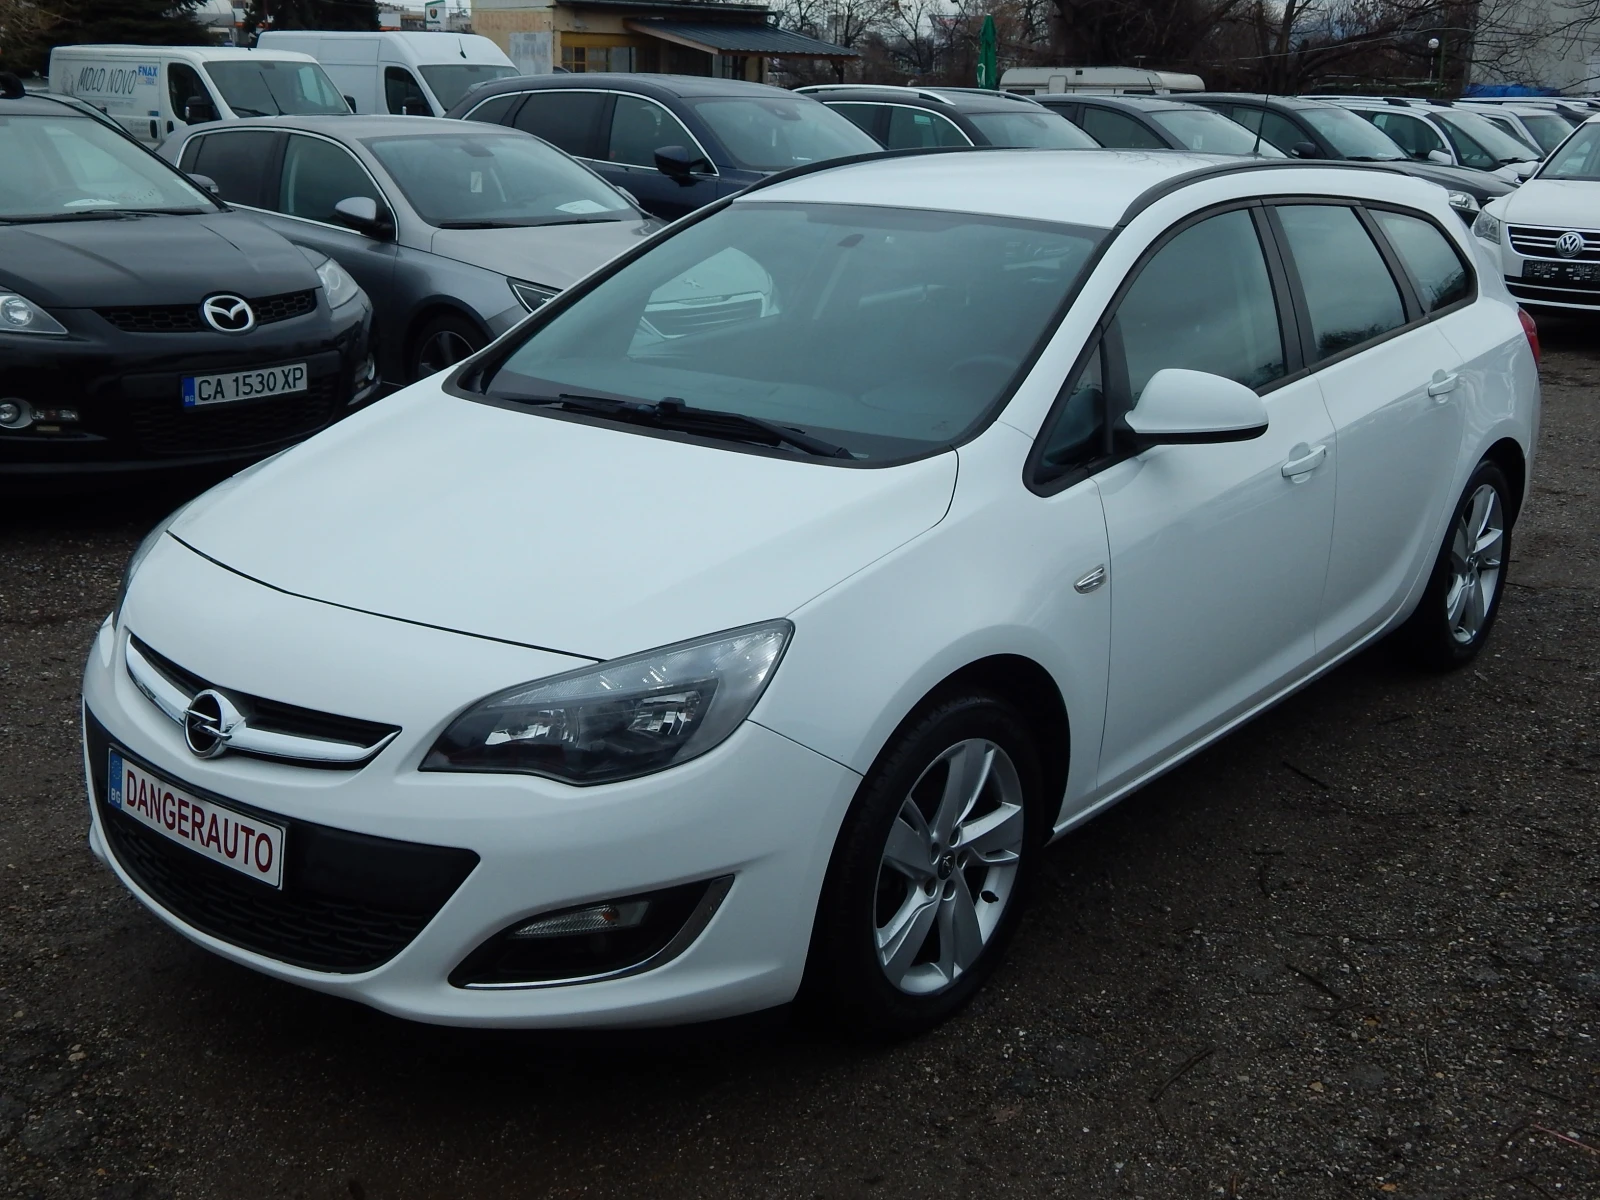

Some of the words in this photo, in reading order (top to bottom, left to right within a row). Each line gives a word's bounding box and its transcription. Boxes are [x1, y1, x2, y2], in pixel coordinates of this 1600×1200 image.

[77, 66, 106, 92] MOLO
[106, 68, 137, 95] NOVO
[1558, 233, 1581, 254] VW
[198, 378, 225, 401] CA
[233, 371, 277, 397] 1530
[281, 367, 304, 390] XP
[111, 787, 121, 803] BG
[127, 769, 273, 873] DANGERAUTO
